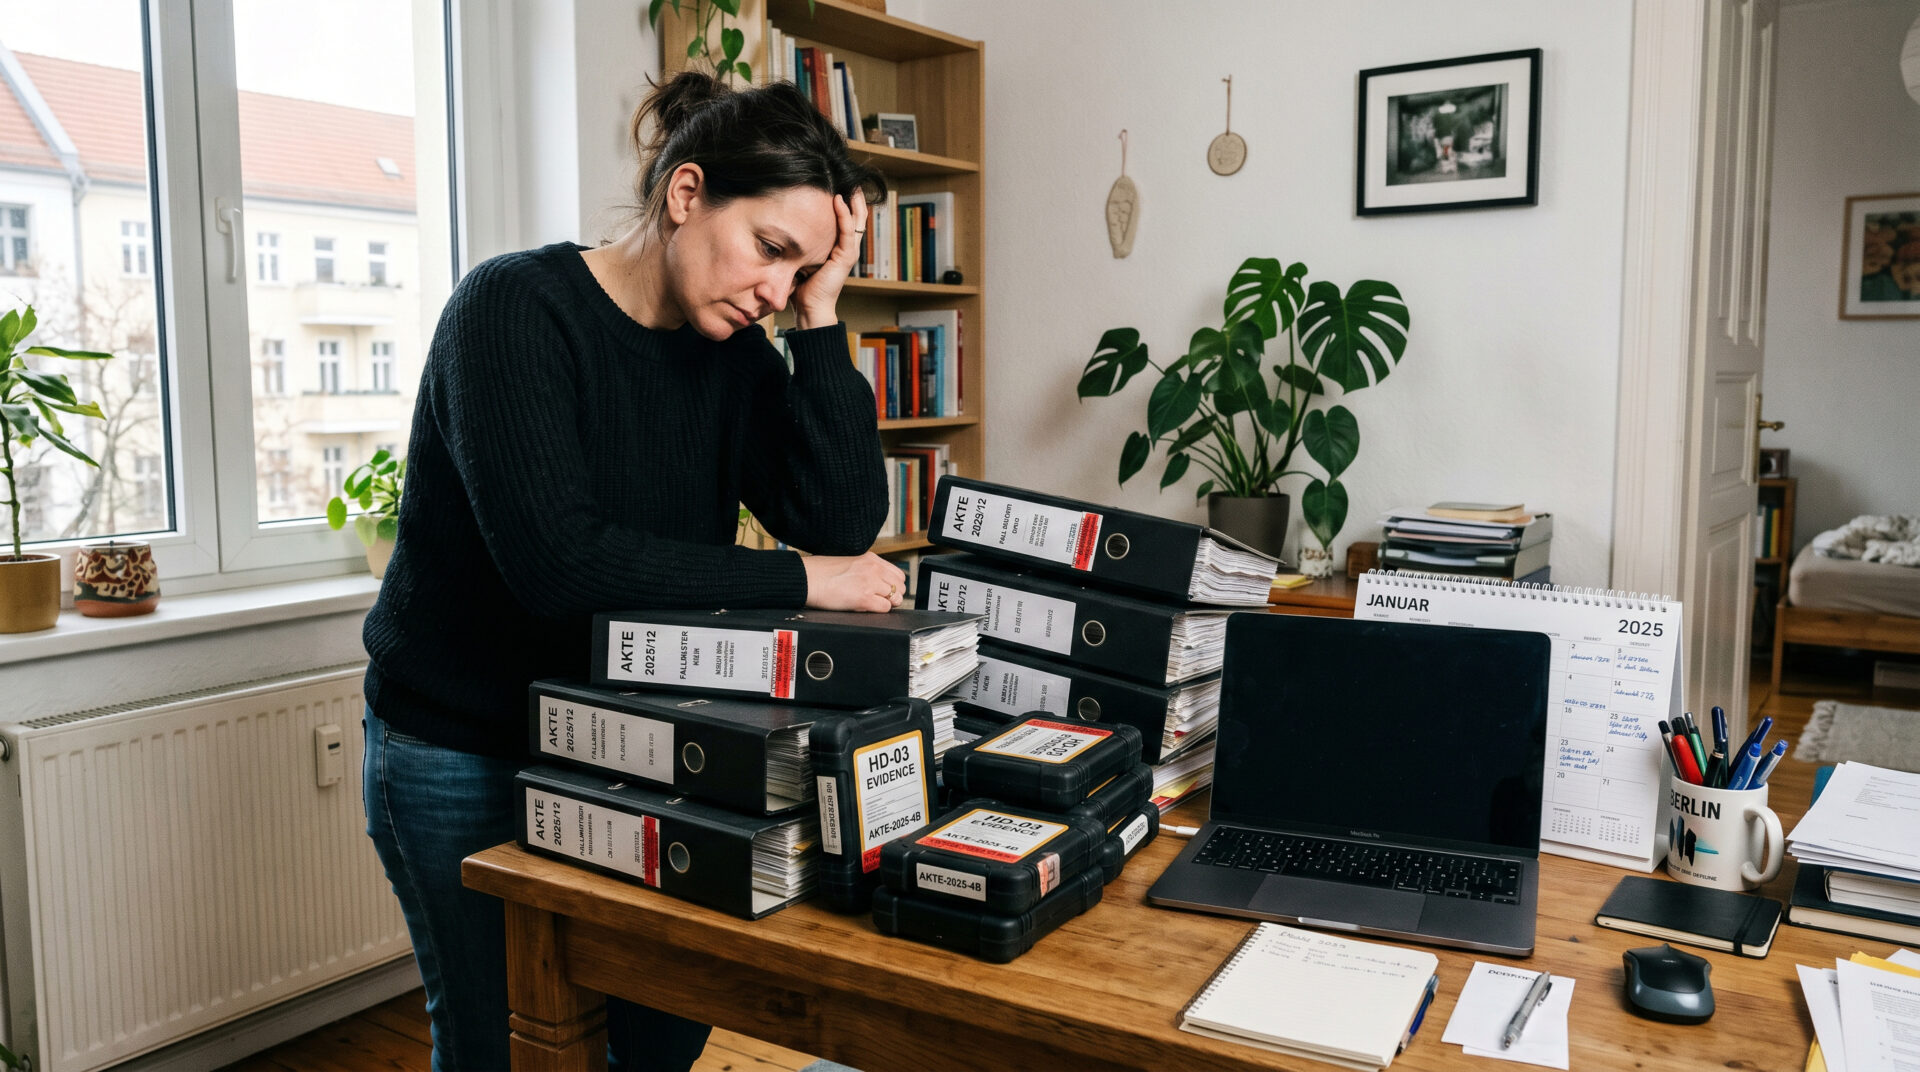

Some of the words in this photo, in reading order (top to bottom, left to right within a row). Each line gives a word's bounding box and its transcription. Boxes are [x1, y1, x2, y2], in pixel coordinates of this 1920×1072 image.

[953, 496, 969, 532] AKTE
[938, 581, 949, 612] KTE
[1366, 593, 1430, 612] JANUAR
[1617, 619, 1664, 637] 2025
[620, 631, 635, 674] AKTE
[645, 630, 657, 676] 2025/12
[548, 706, 558, 748] AKTE
[566, 708, 574, 752] 2025/12
[868, 745, 910, 773] HD-03
[1606, 745, 1614, 753] 24
[866, 763, 915, 790] EVIDENCE
[535, 798, 545, 841] AKTE
[552, 801, 562, 846] 2025/12
[868, 811, 922, 840] AKTE-2025-4B
[970, 819, 1040, 836] EVIDENCE
[919, 872, 982, 892] AKTE-2025-4B
